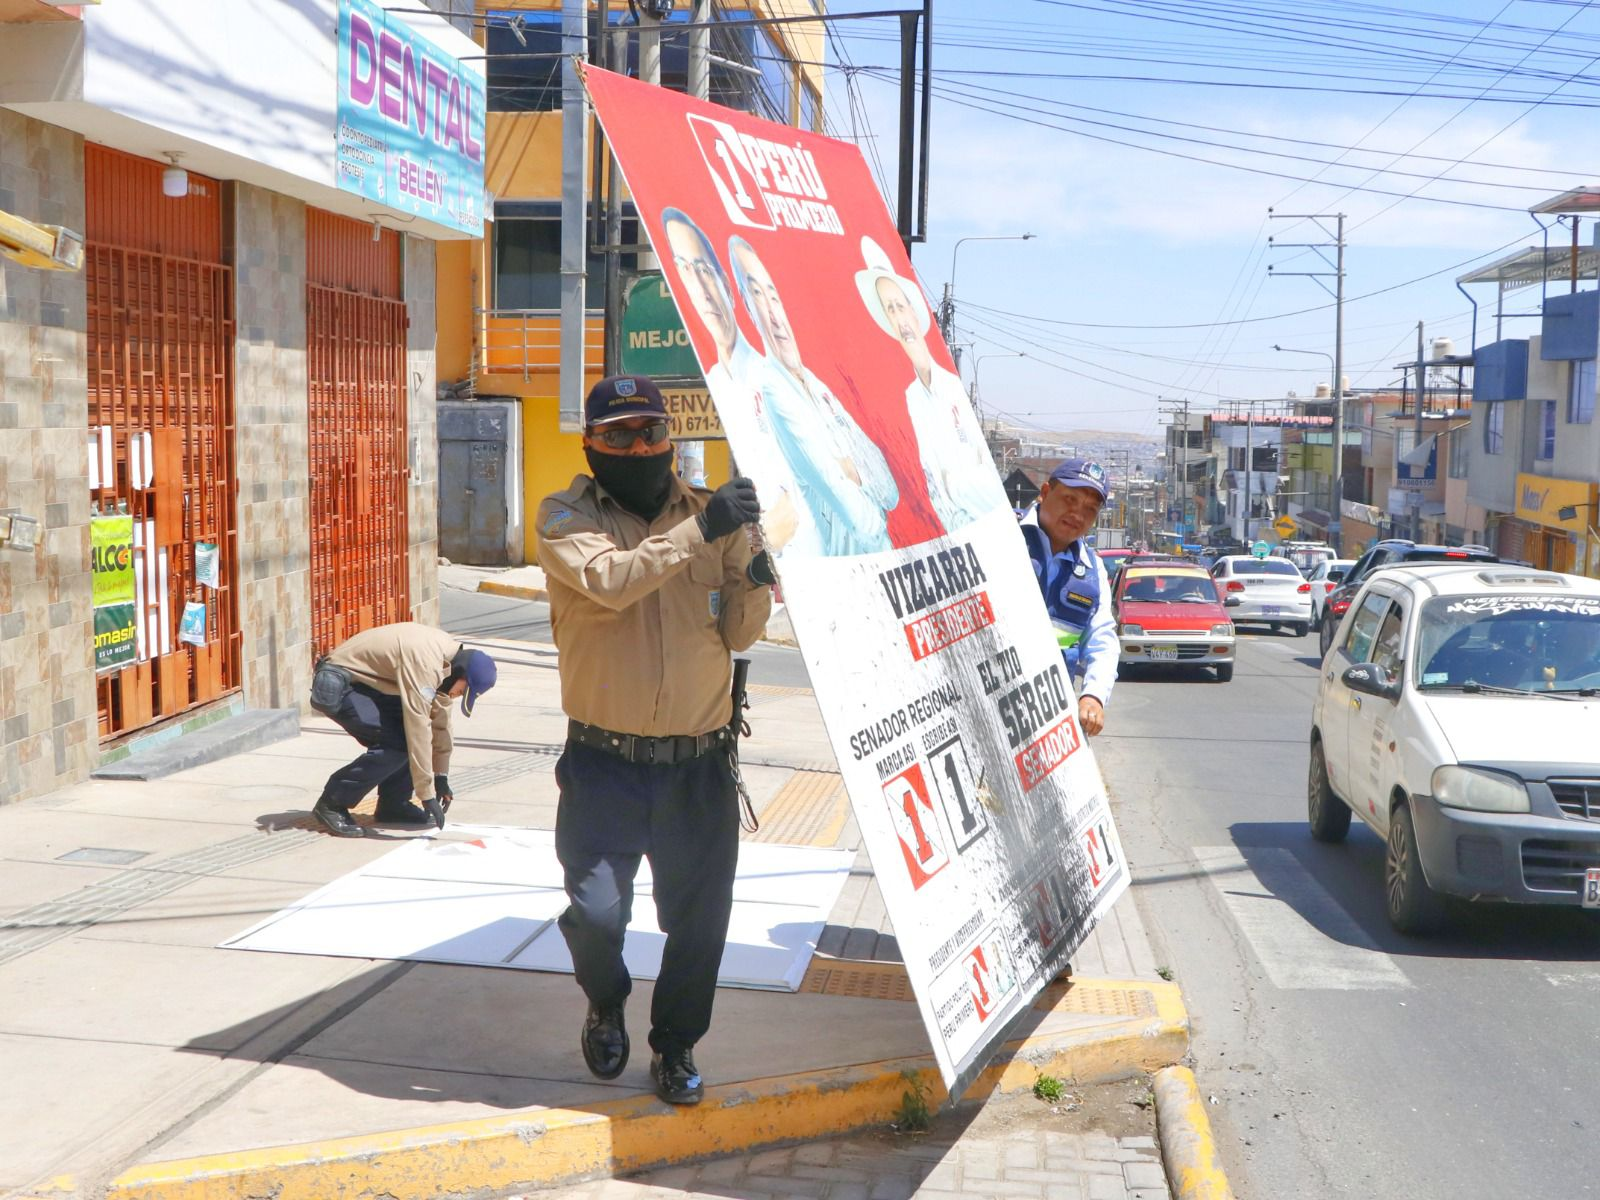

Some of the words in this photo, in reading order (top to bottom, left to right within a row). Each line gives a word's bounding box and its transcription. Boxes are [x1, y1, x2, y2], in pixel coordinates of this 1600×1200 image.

[350, 12, 482, 162] DENTAL
[399, 160, 444, 206] BELÉN
[738, 132, 828, 200] PERÚ
[763, 192, 845, 235] PRIMERO
[629, 329, 690, 349] MEJO
[878, 542, 987, 620] VIZCARRA
[911, 597, 990, 657] PRESIDENTE
[976, 658, 999, 696] EL
[997, 645, 1023, 685] TIO
[849, 708, 910, 761] SENADOR
[907, 680, 962, 727] REGIONAL
[921, 723, 949, 751] ESCRIBE
[998, 664, 1069, 750] SERGIO
[876, 749, 905, 780] MARCA
[902, 741, 917, 765] ASI
[1021, 721, 1076, 785] SENADOR
[944, 751, 977, 836] 1
